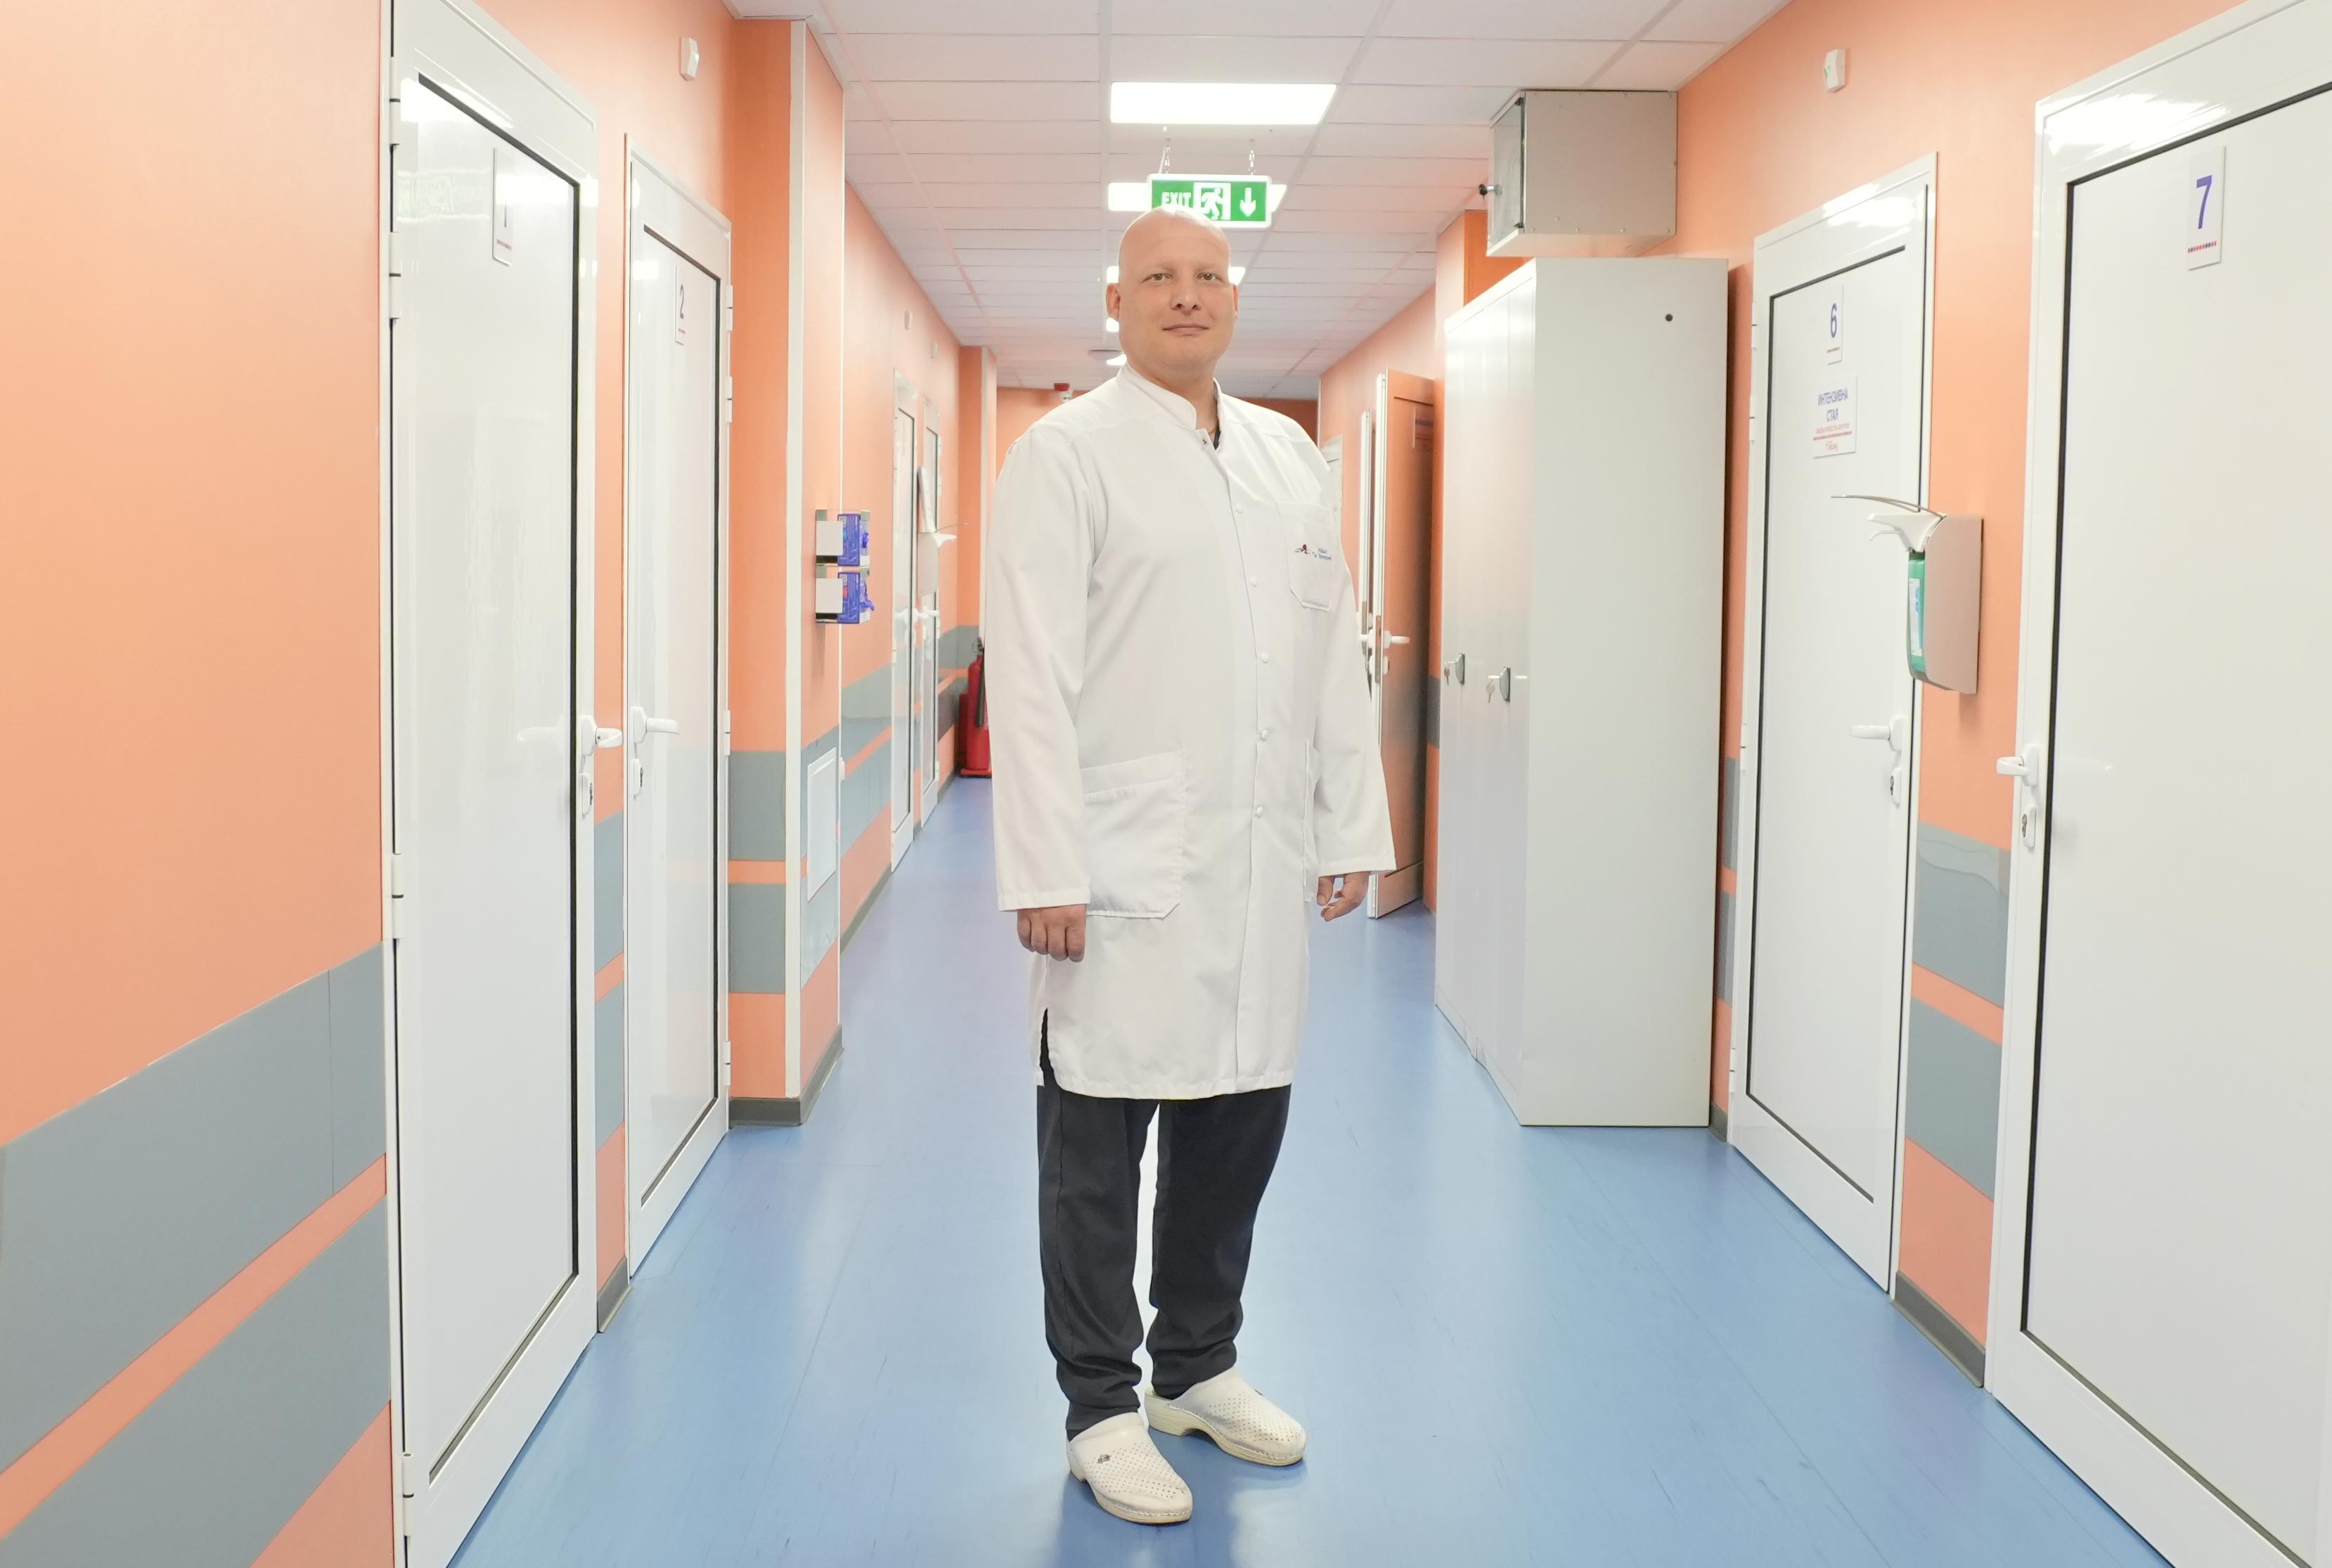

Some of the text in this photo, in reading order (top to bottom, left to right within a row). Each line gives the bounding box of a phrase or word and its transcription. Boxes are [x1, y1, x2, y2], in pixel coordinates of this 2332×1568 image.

[1161, 192, 1192, 207] EXIT
[2196, 175, 2212, 230] 7
[680, 284, 684, 320] 2
[1830, 303, 1838, 338] 6
[1817, 388, 1848, 406] ИНТЕНЗИВНА
[1827, 408, 1839, 422] СТАЯ
